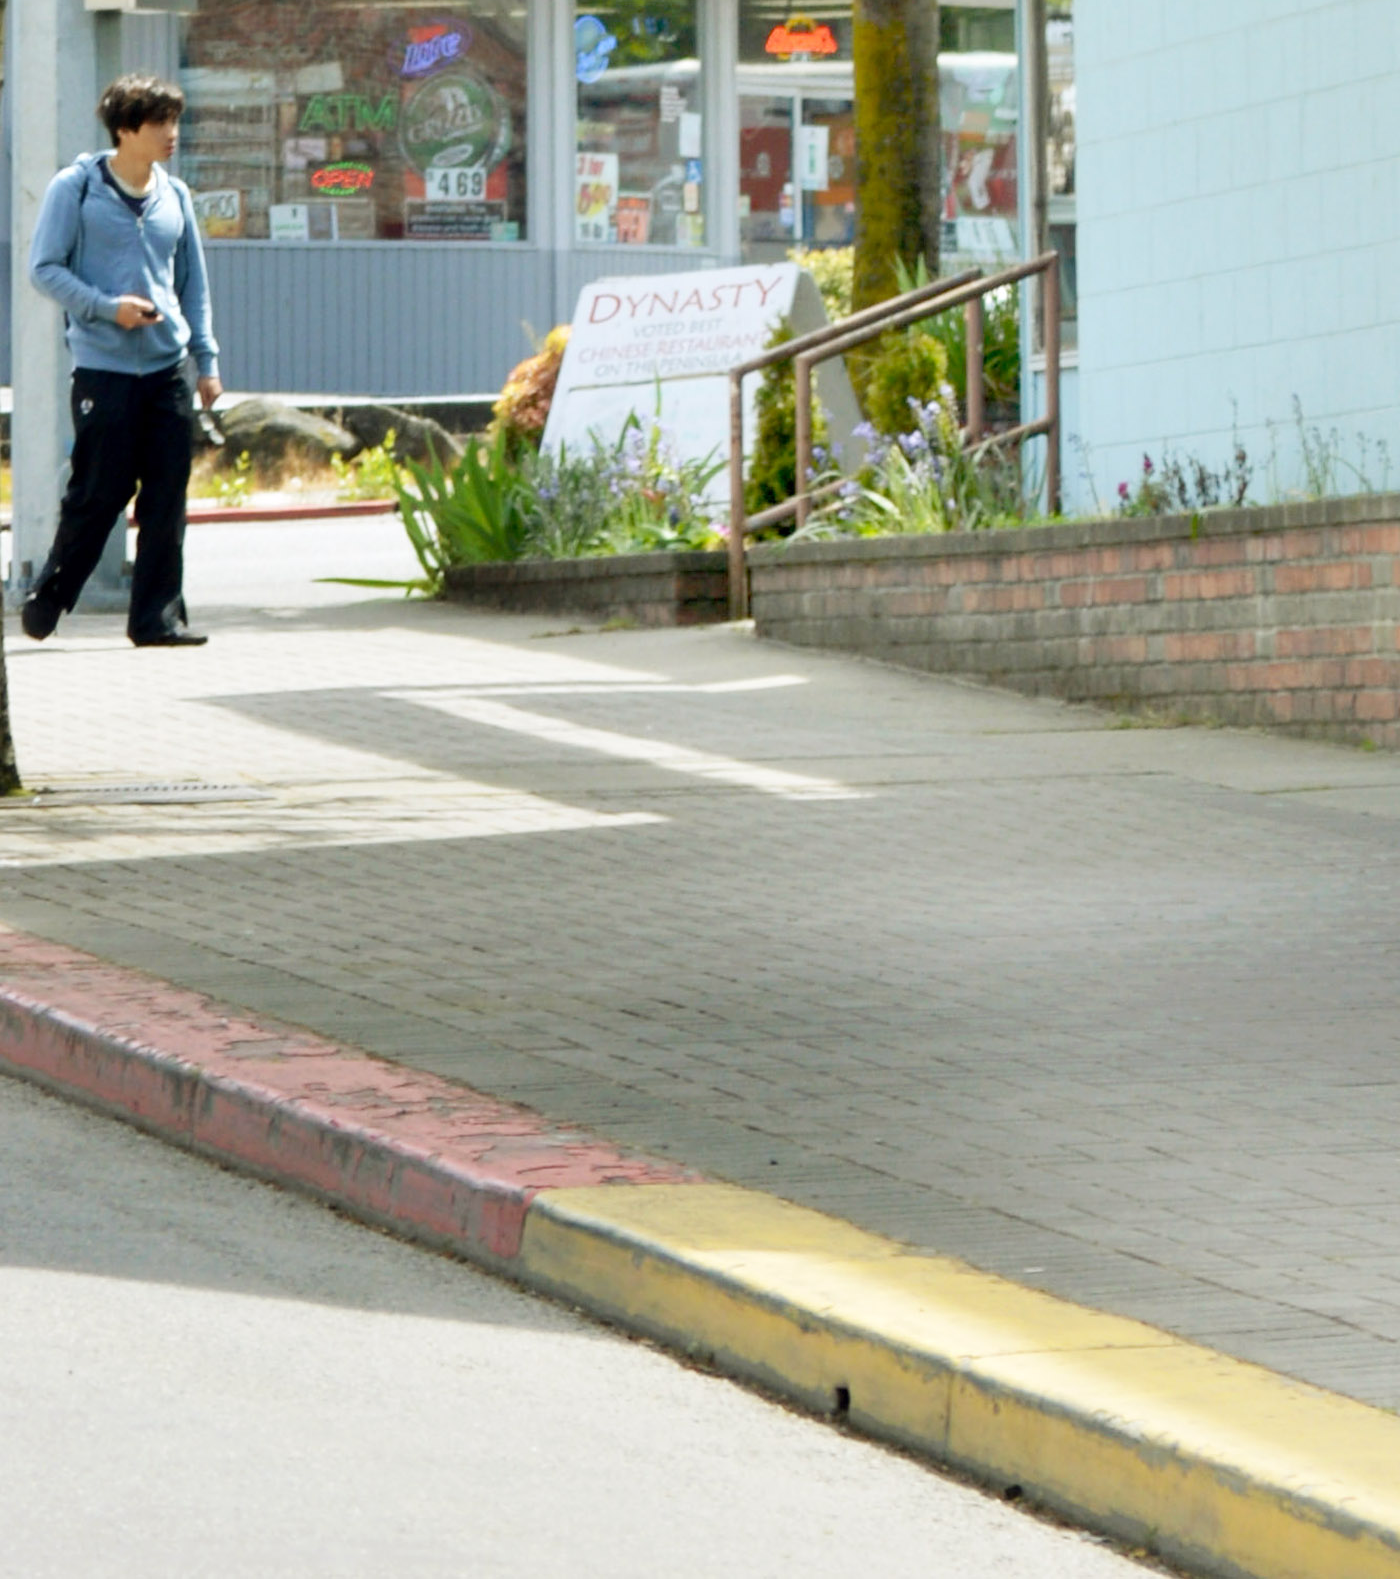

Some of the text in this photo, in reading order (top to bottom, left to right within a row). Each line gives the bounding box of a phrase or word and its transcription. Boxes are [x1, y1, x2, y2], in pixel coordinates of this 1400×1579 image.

[299, 92, 399, 132] ATM
[310, 168, 376, 189] OPEN
[588, 275, 783, 325] DYNASTY
[633, 318, 723, 339] VOTED BEST
[578, 342, 649, 364] CHINESE
[594, 363, 620, 378] ON
